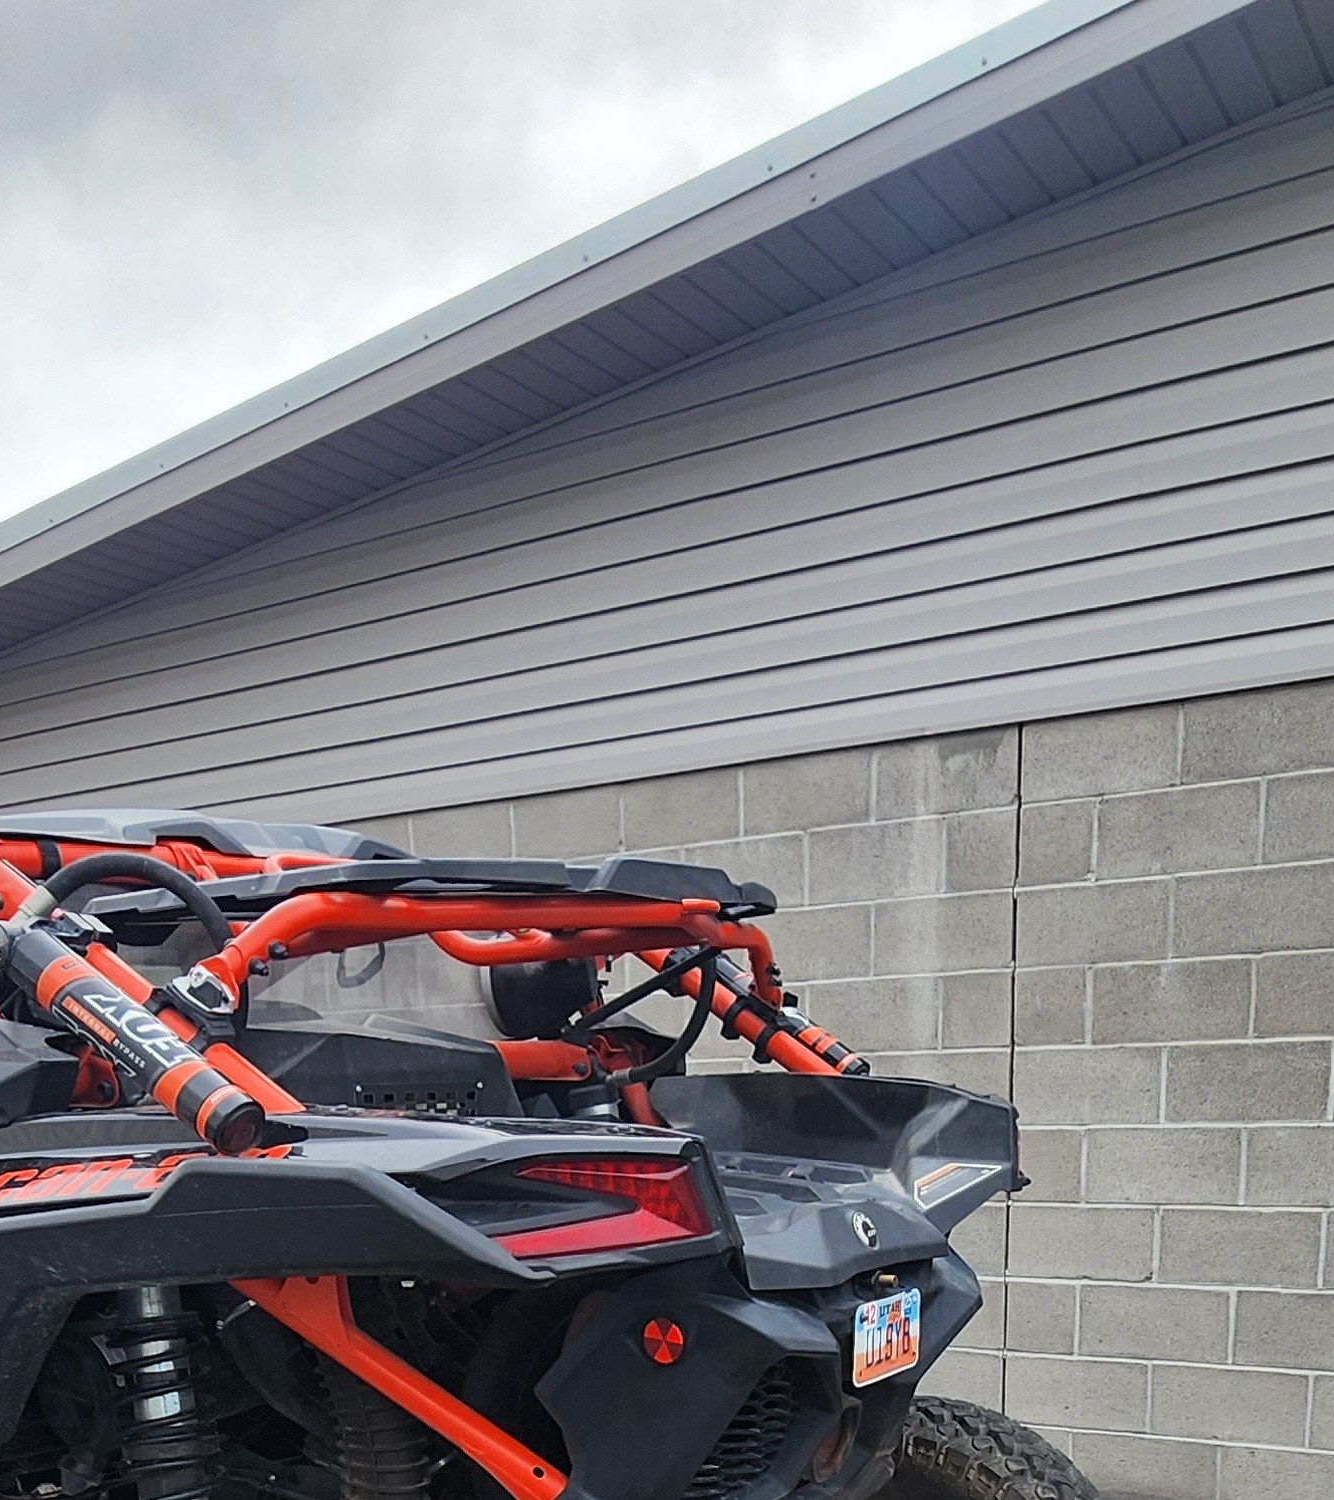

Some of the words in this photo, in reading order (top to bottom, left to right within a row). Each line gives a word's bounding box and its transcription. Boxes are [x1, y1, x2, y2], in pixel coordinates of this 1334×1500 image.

[68, 1001, 114, 1041] INTERNAL
[113, 1038, 147, 1069] BYPASS
[878, 1299, 902, 1317] UTAH
